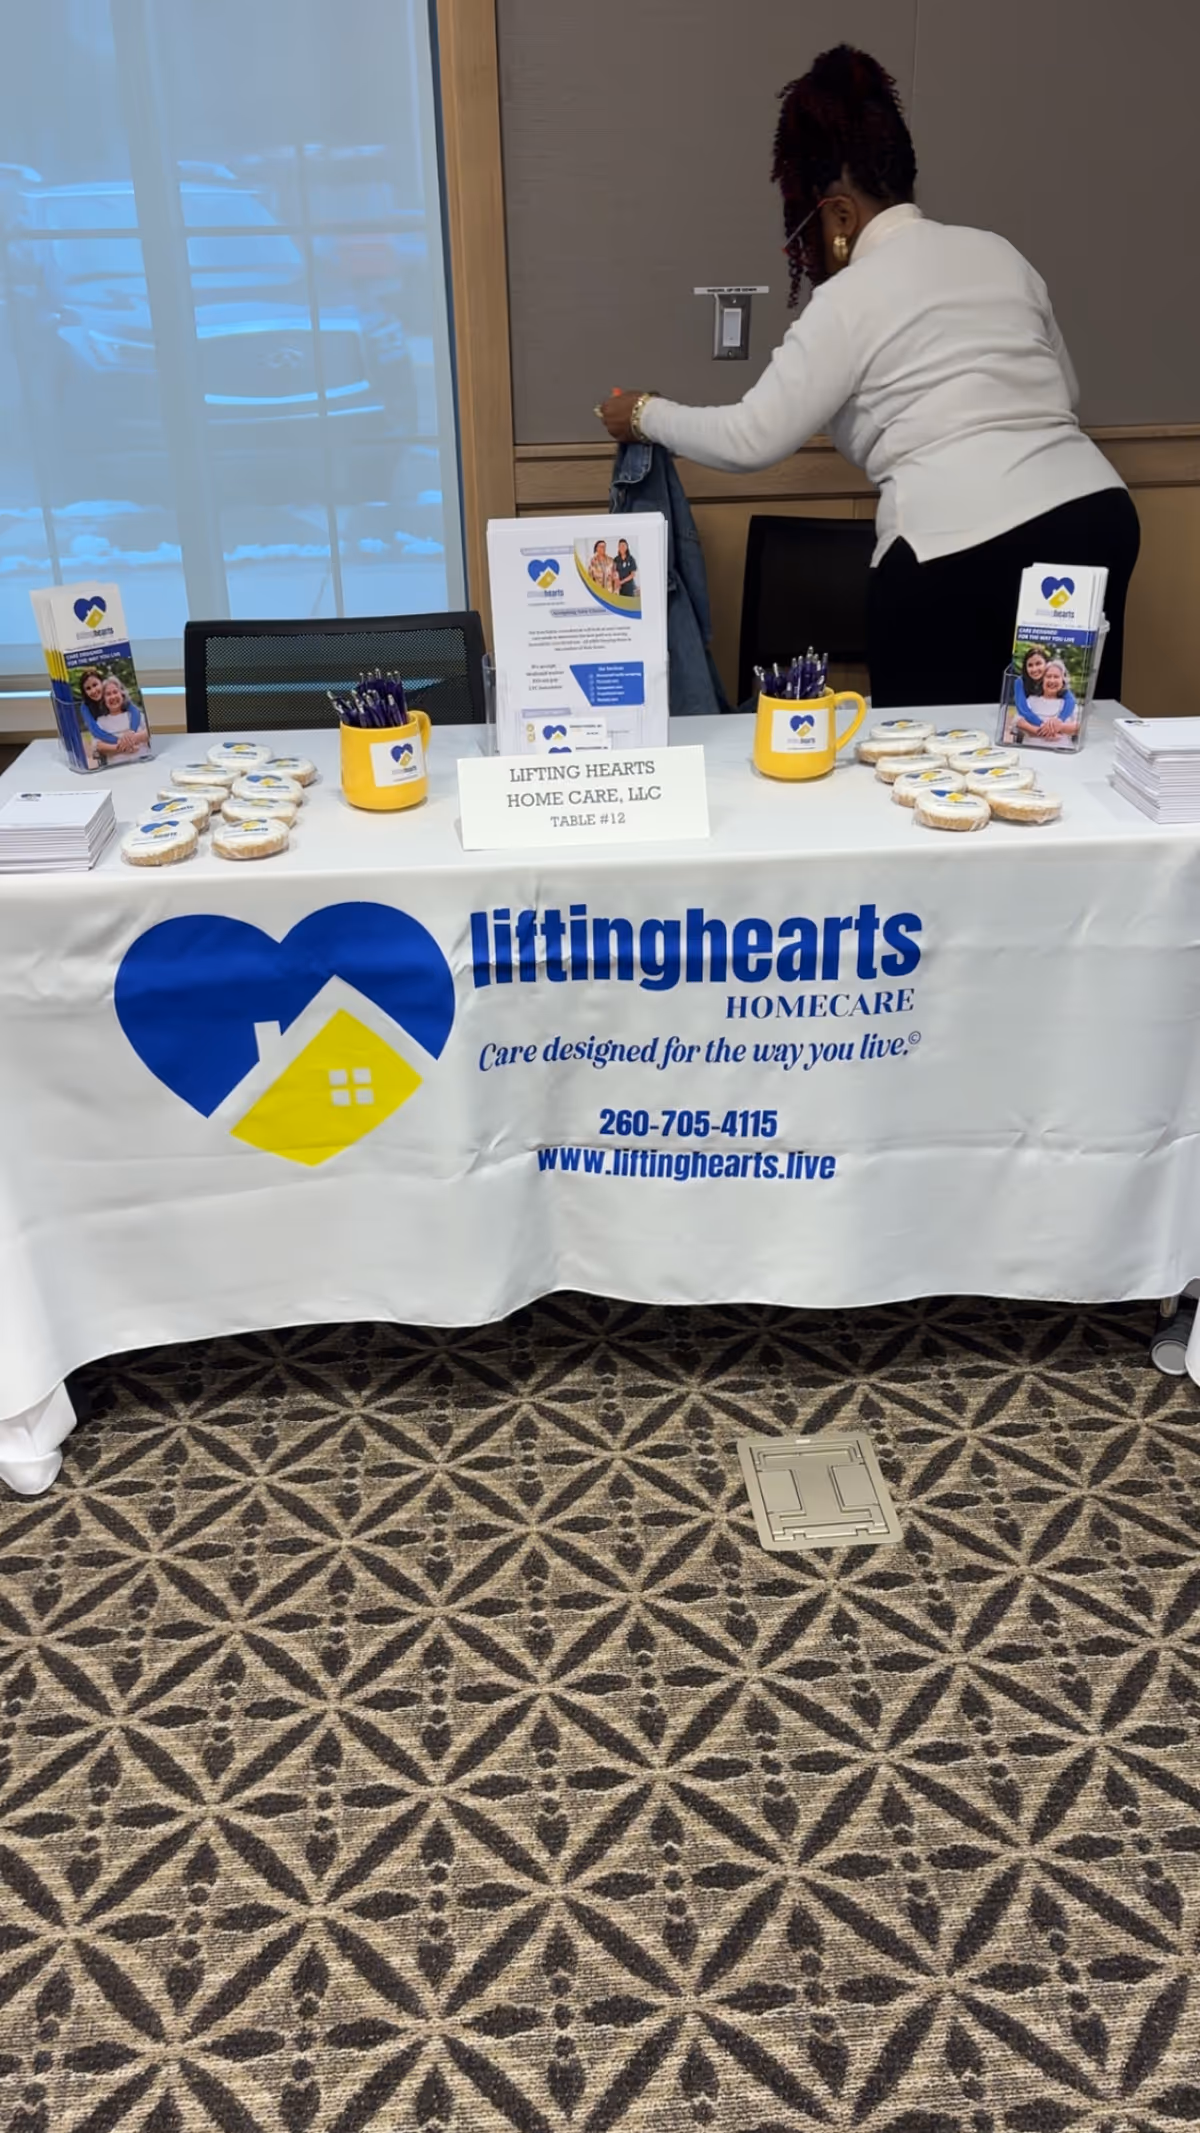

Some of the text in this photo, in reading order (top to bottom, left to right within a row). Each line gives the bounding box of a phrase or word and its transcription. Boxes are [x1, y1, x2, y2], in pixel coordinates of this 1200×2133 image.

[509, 760, 656, 783] LIFTING HEARTS
[507, 785, 663, 808] HOME CARE, LLC
[550, 812, 626, 828] TABLE #12
[470, 903, 923, 992] liftinghearts
[725, 988, 916, 1020] HOMECARE
[479, 1043, 537, 1072] Care
[542, 1036, 656, 1069] designed
[656, 1036, 701, 1071] for
[705, 1035, 747, 1063] the
[752, 1042, 803, 1071] way
[802, 1041, 854, 1071] you
[599, 1108, 779, 1138] 260-705-4115
[537, 1147, 837, 1182] www.liftinghearts.live
